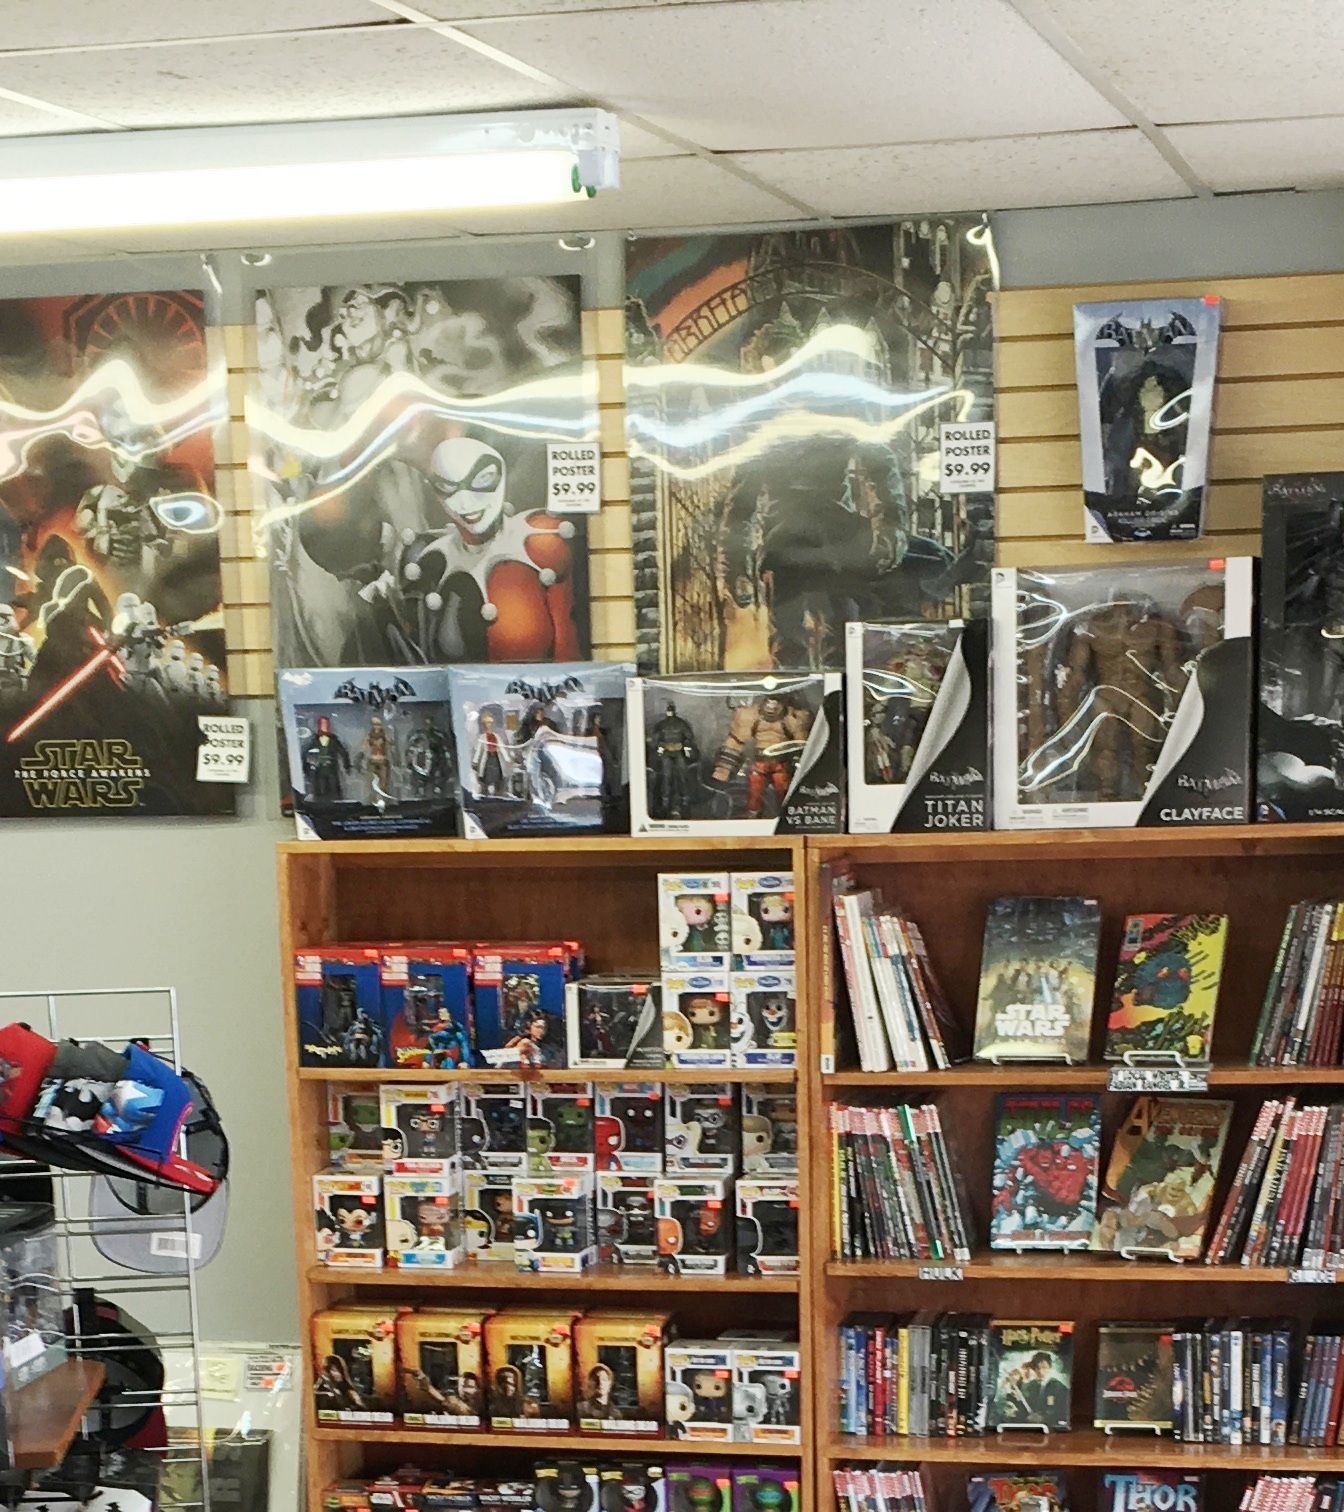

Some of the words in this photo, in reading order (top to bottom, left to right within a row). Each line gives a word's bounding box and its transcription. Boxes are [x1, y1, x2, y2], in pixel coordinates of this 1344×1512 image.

[945, 430, 991, 441] ROLLED
[552, 450, 596, 460] ROLLED
[945, 445, 991, 456] POSTER
[552, 465, 596, 476] POSTER
[944, 462, 991, 477] $9.99
[552, 482, 596, 496] $9.99
[202, 723, 245, 734] ROLLED
[205, 738, 244, 749] POSTER
[20, 739, 142, 769] STAR
[202, 753, 244, 766] $9.99
[14, 769, 37, 779] THE
[43, 769, 87, 779] FORCE
[90, 768, 151, 778] AWAKENS
[23, 778, 145, 808] WARS
[788, 805, 836, 816] BATMAN
[924, 800, 984, 814] TITAN
[924, 814, 984, 828] JOKER
[1160, 807, 1244, 822] CLAYFACE
[995, 1003, 1071, 1021] STAR
[995, 1020, 1070, 1037] WARS
